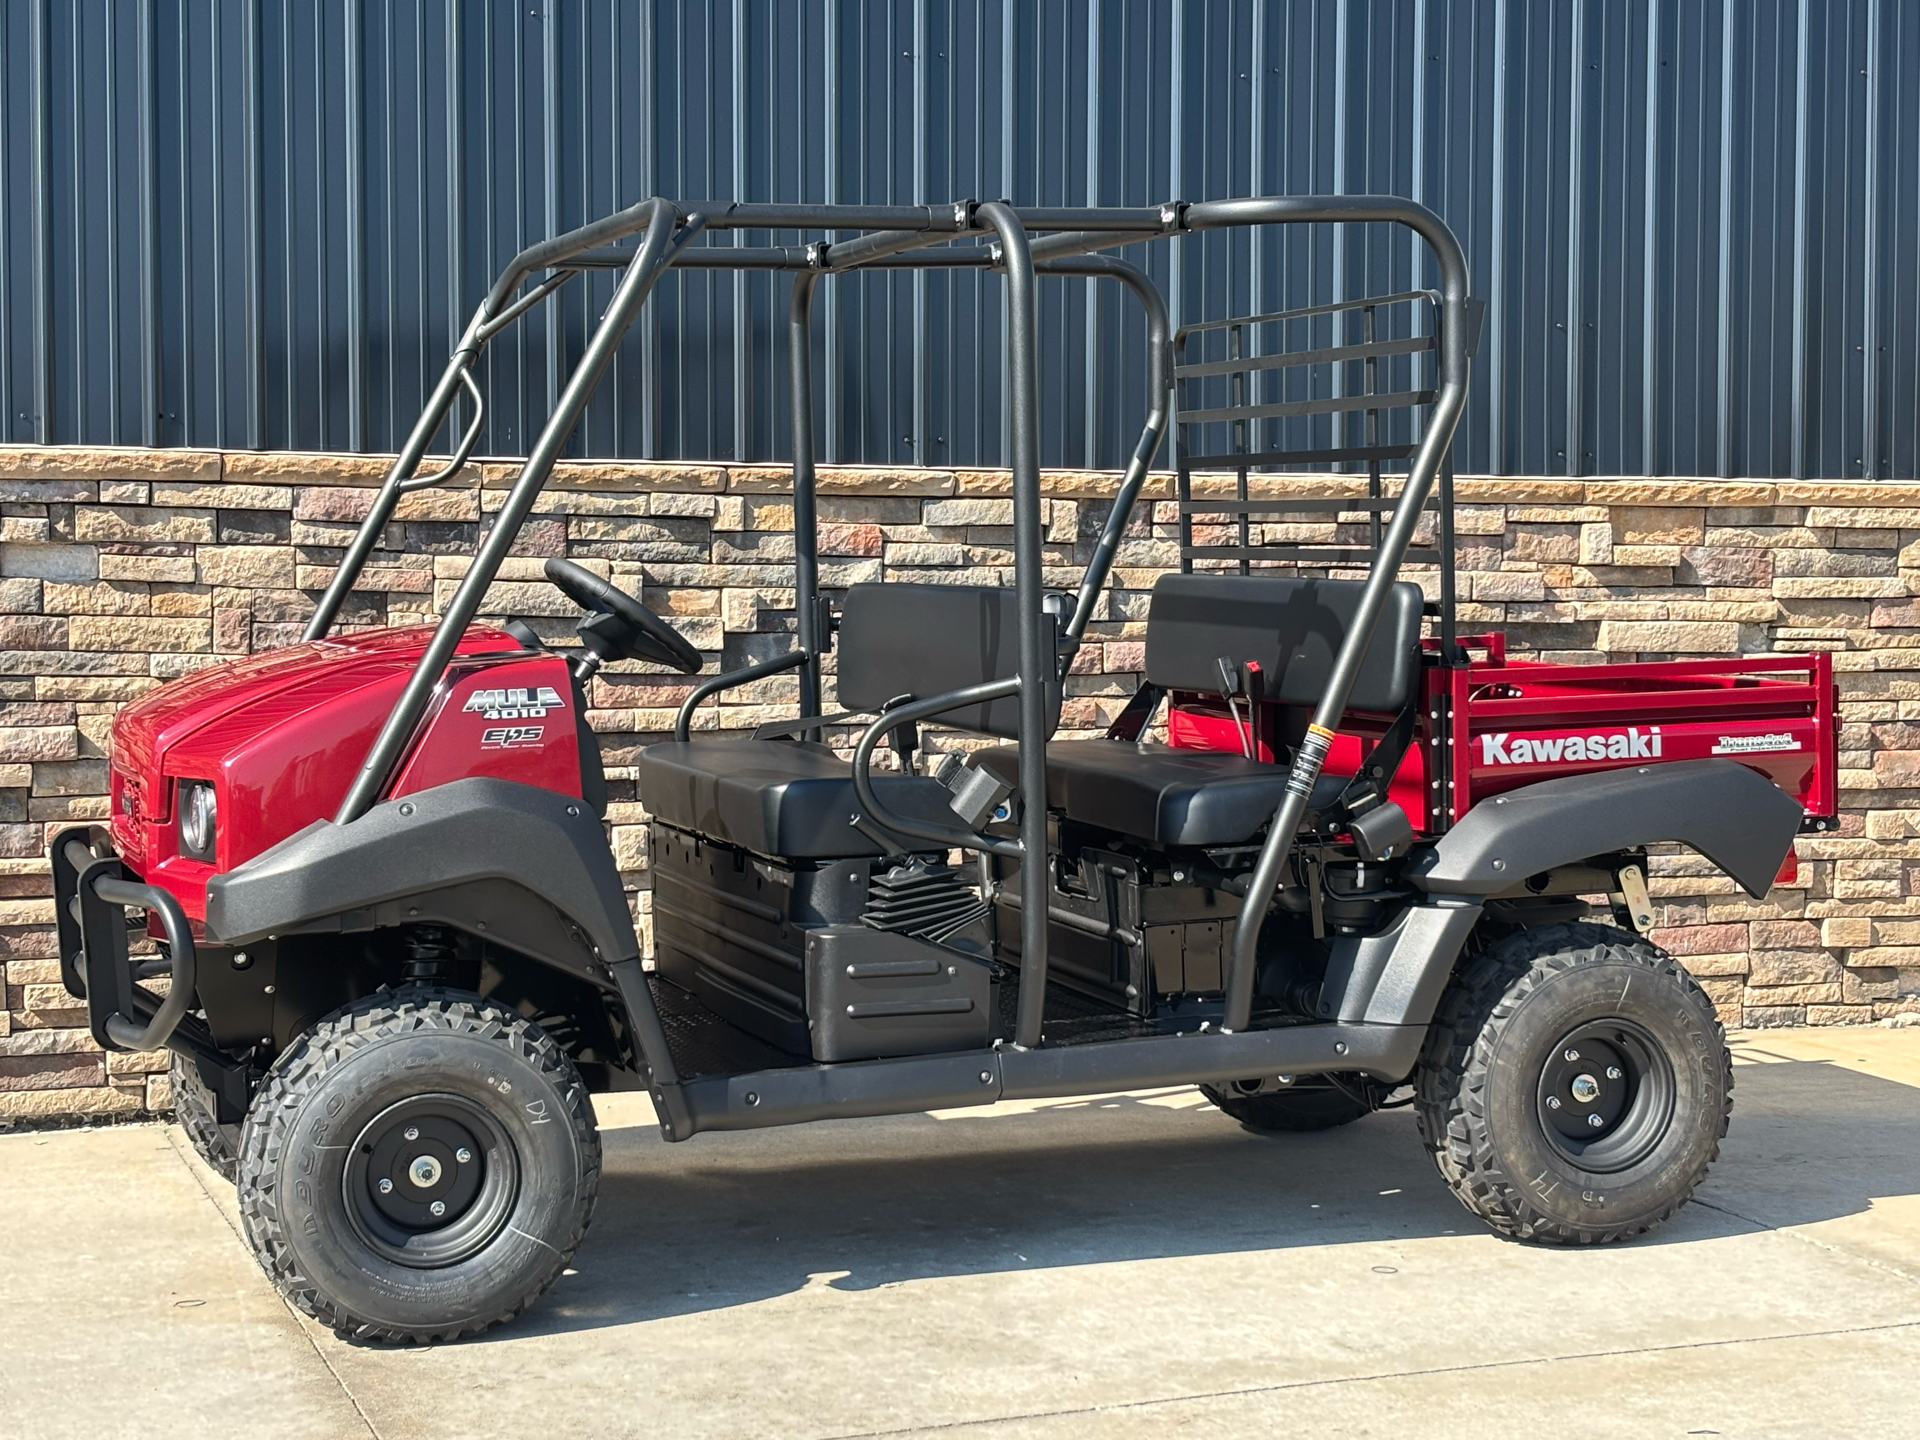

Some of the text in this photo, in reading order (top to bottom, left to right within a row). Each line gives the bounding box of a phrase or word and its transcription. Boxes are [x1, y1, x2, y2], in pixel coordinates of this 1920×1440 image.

[462, 687, 566, 711] MULE
[483, 708, 547, 719] 4010
[1481, 727, 1662, 765] Kawasaki
[295, 1092, 346, 1207] DURO
